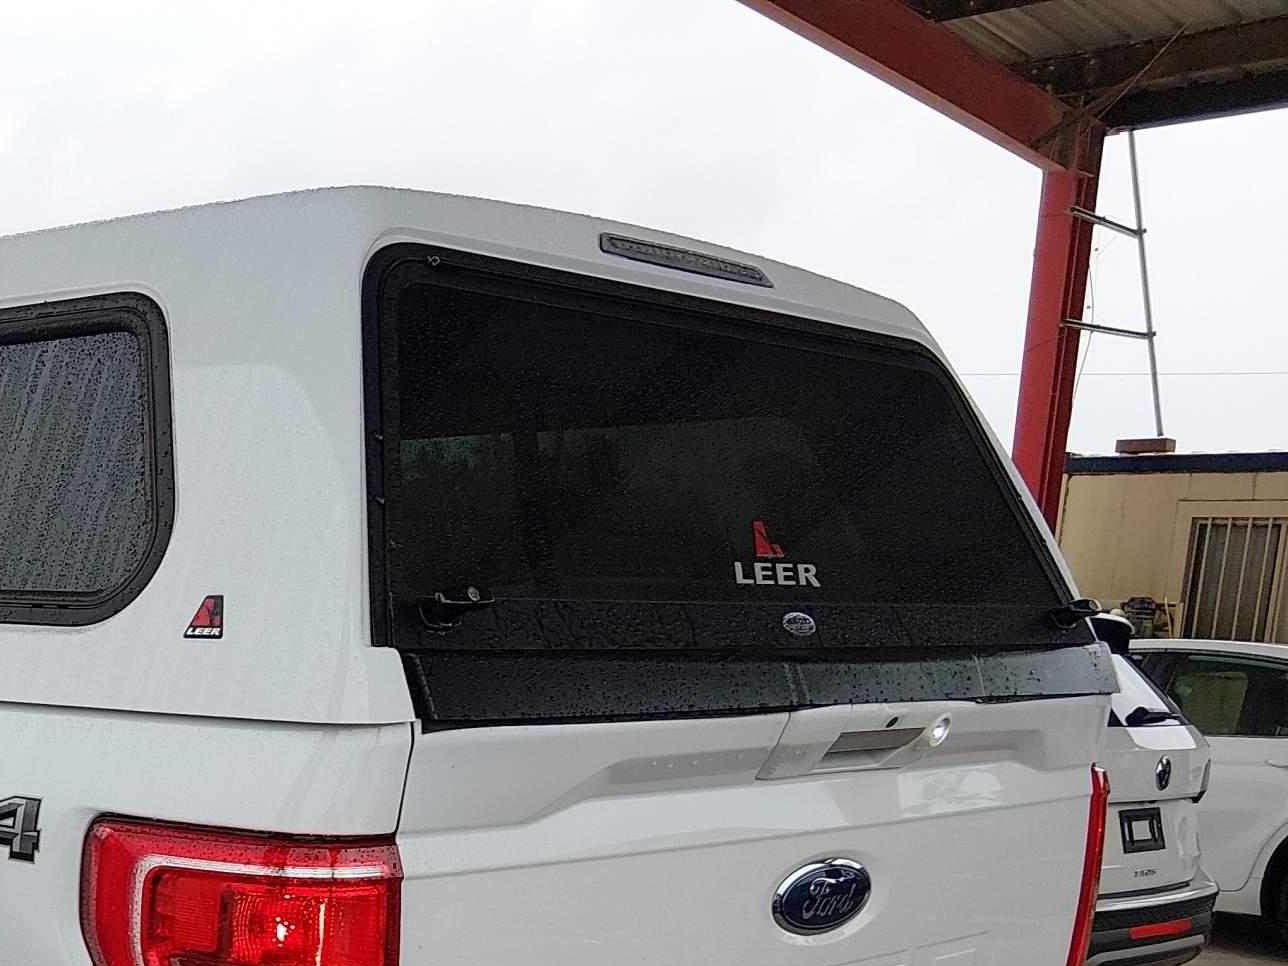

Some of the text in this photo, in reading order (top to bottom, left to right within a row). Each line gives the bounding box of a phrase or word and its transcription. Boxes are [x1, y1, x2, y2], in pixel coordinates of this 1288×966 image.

[734, 561, 821, 587] LEER
[186, 627, 221, 636] LEER
[802, 877, 857, 920] Ford
